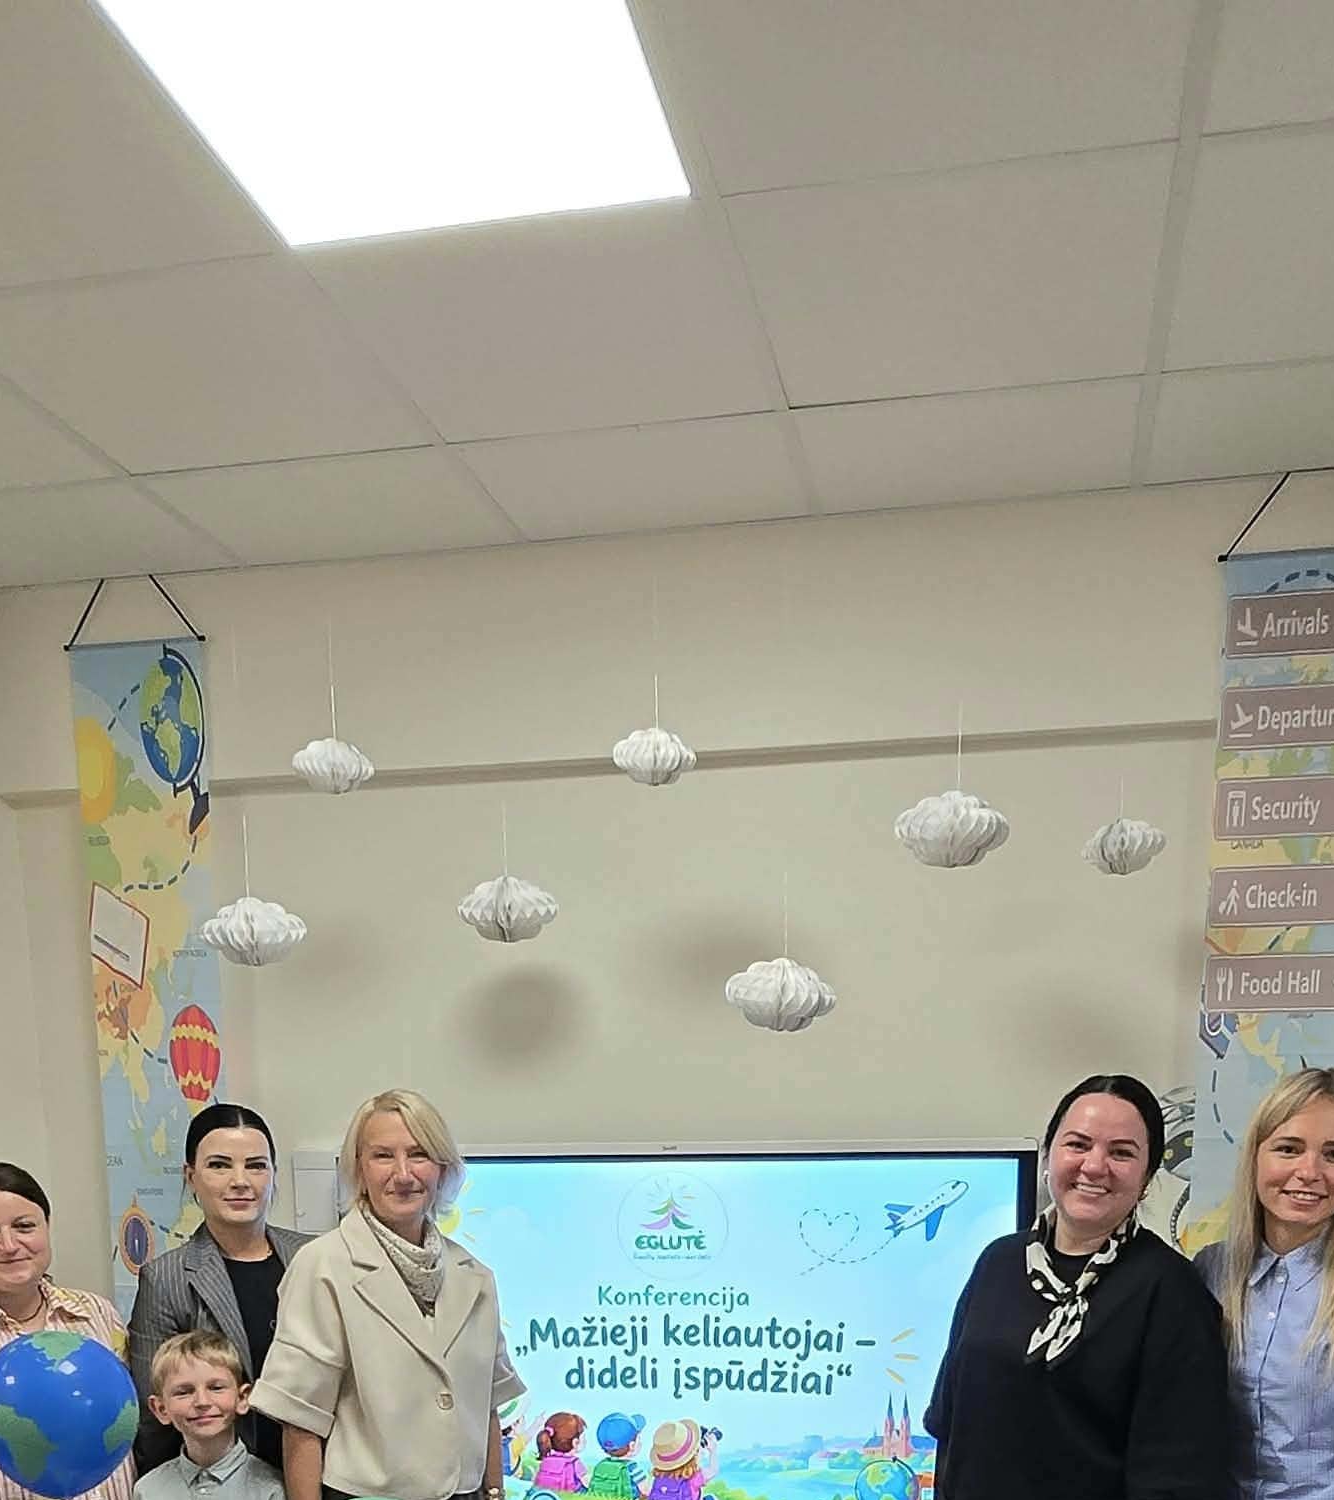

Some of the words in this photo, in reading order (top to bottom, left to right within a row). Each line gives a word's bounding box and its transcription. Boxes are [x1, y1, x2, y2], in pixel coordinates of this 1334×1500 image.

[1262, 608, 1329, 638] Arrivals
[1251, 792, 1321, 825] Security
[1245, 880, 1317, 909] Check-in
[1241, 970, 1283, 995] Food
[1287, 969, 1321, 994] Hall
[634, 1229, 708, 1251] EGLUTĖ
[597, 1284, 751, 1313] Konferencija
[516, 1316, 649, 1357] „Mažieji
[663, 1313, 846, 1361] keliautojai
[565, 1356, 658, 1390] dideli
[672, 1357, 853, 1402] įspūdžiai“
